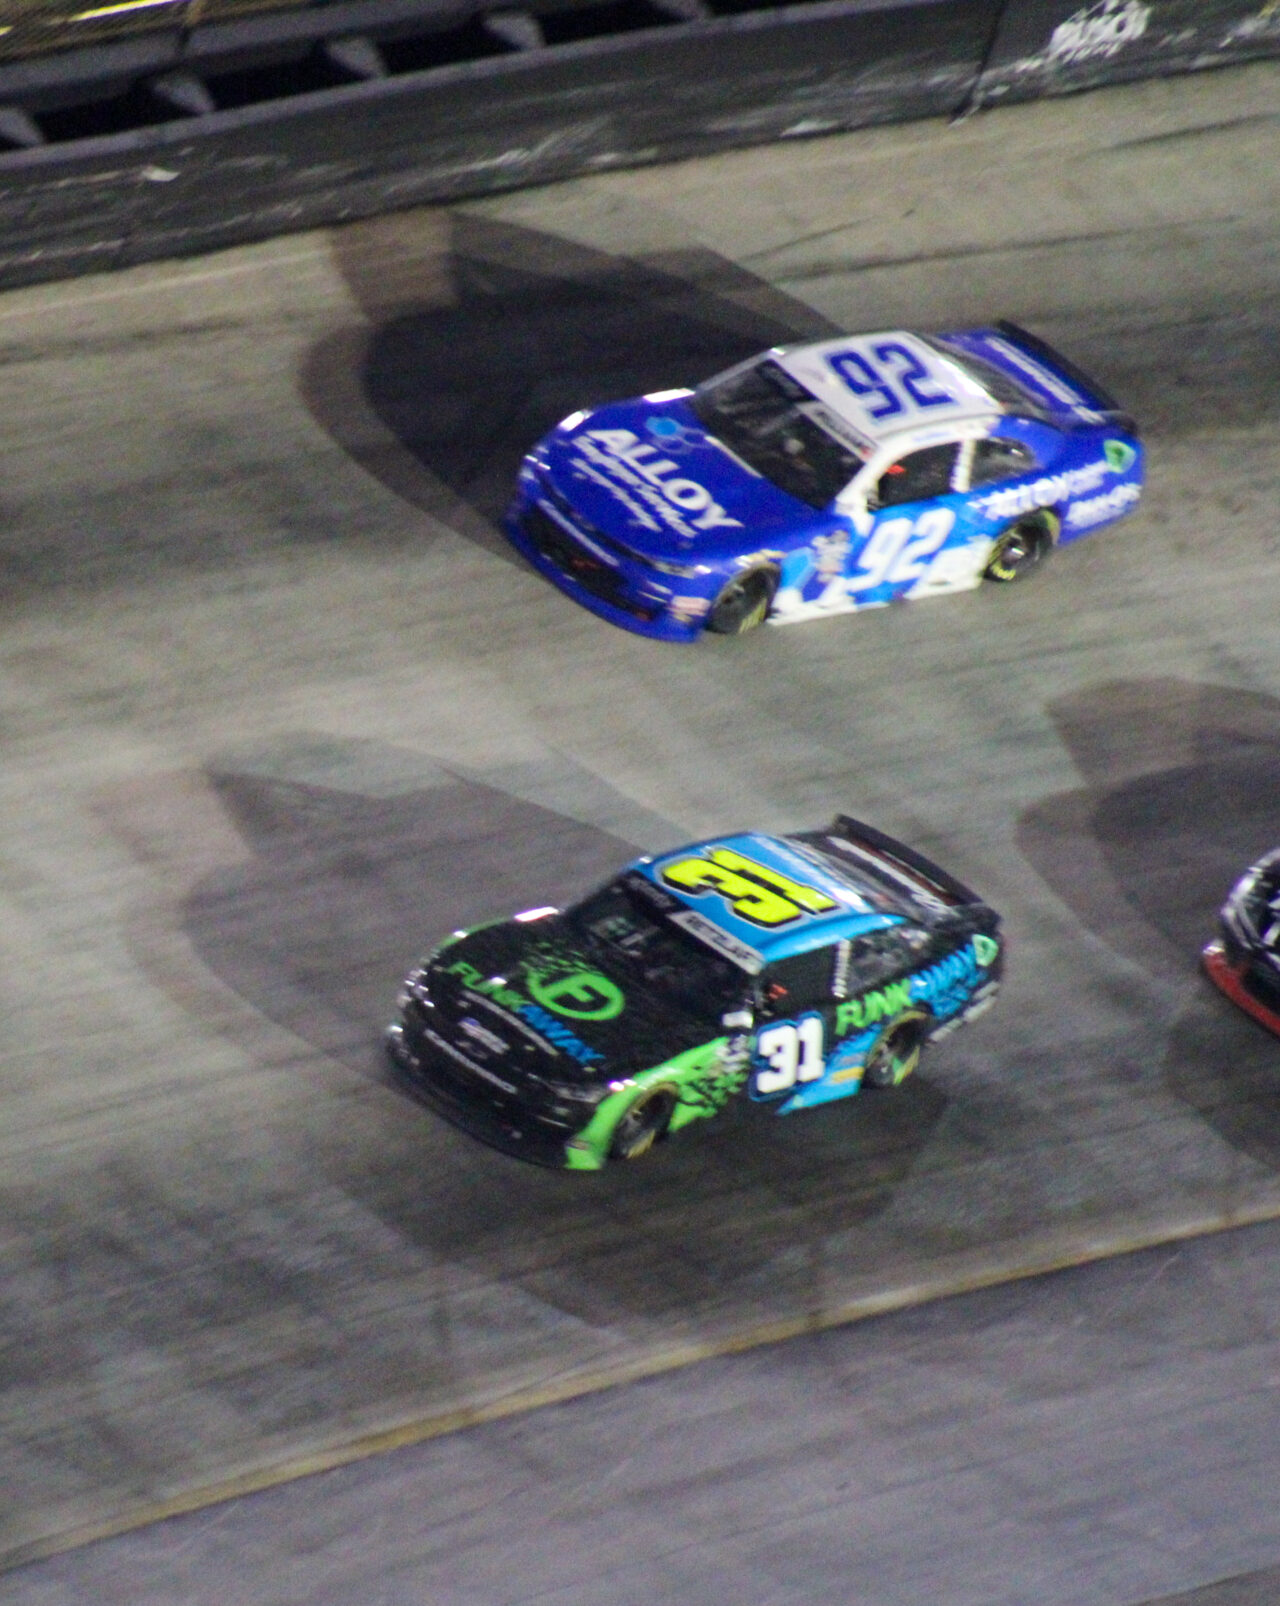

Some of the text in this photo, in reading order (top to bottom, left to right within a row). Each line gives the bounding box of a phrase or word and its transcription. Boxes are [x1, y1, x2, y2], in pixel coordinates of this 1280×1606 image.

[828, 341, 955, 419] 92
[586, 428, 745, 530] ALLOY
[846, 507, 956, 593] 92
[662, 849, 840, 929] 31
[757, 1017, 825, 1093] 31
